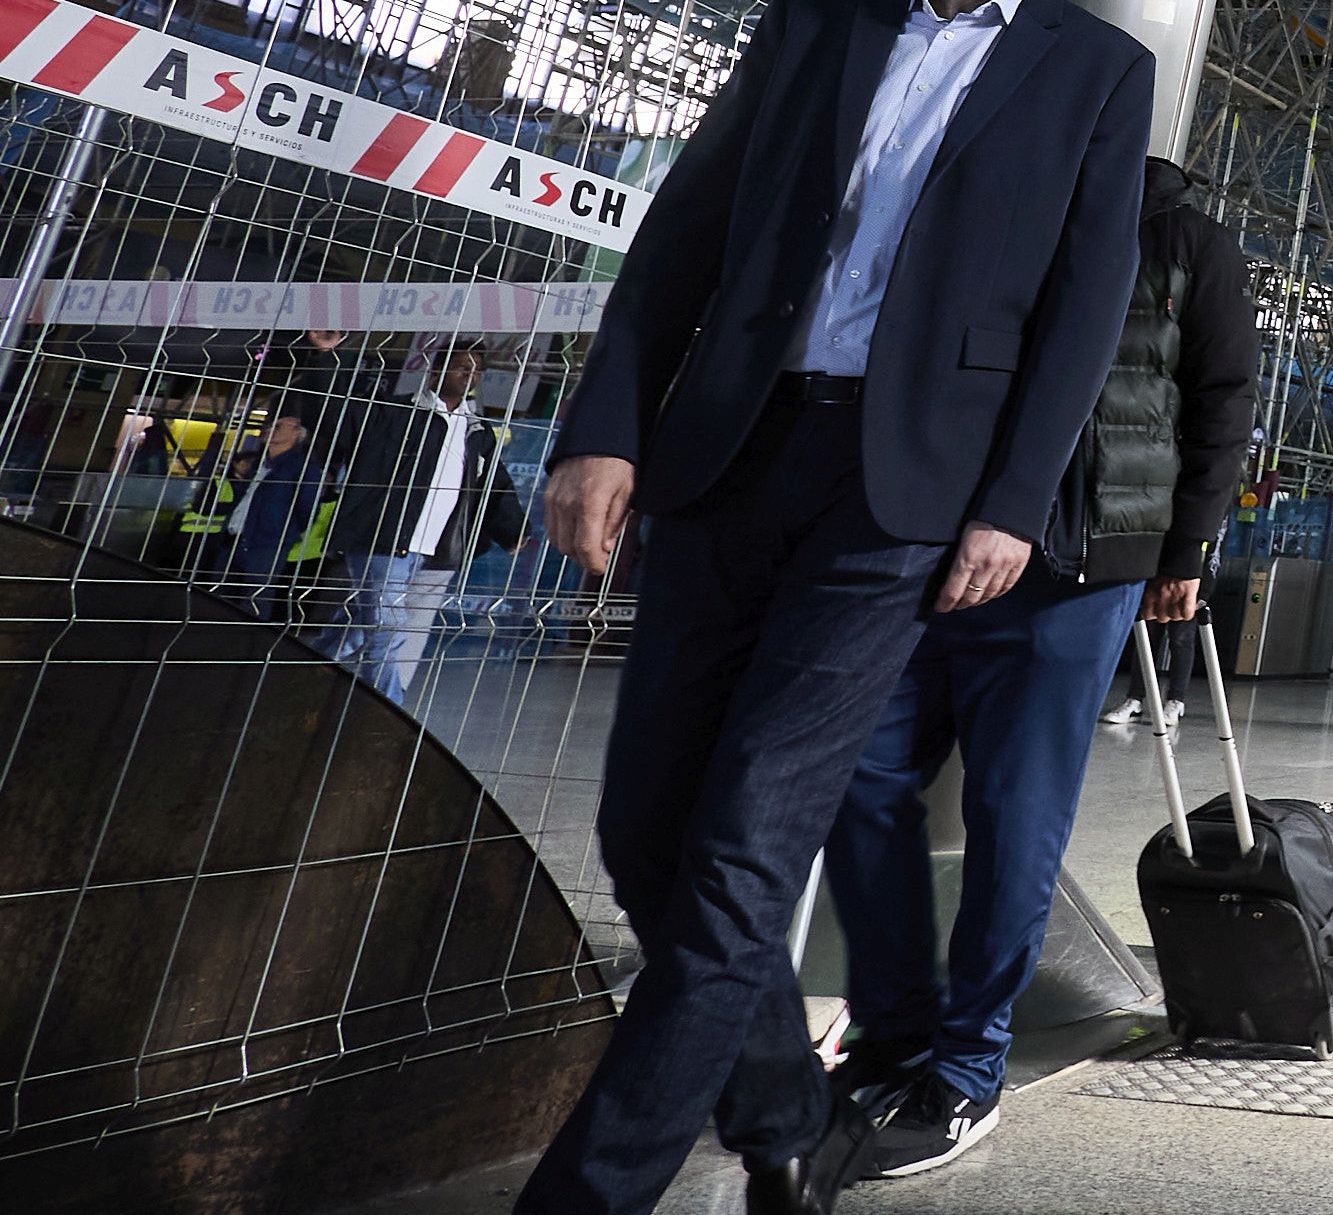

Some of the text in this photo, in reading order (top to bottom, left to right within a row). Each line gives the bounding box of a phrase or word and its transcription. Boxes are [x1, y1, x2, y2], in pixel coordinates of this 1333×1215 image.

[143, 48, 343, 143] ASCH
[259, 132, 304, 151] SERVICIOS
[490, 156, 627, 228] ASCH
